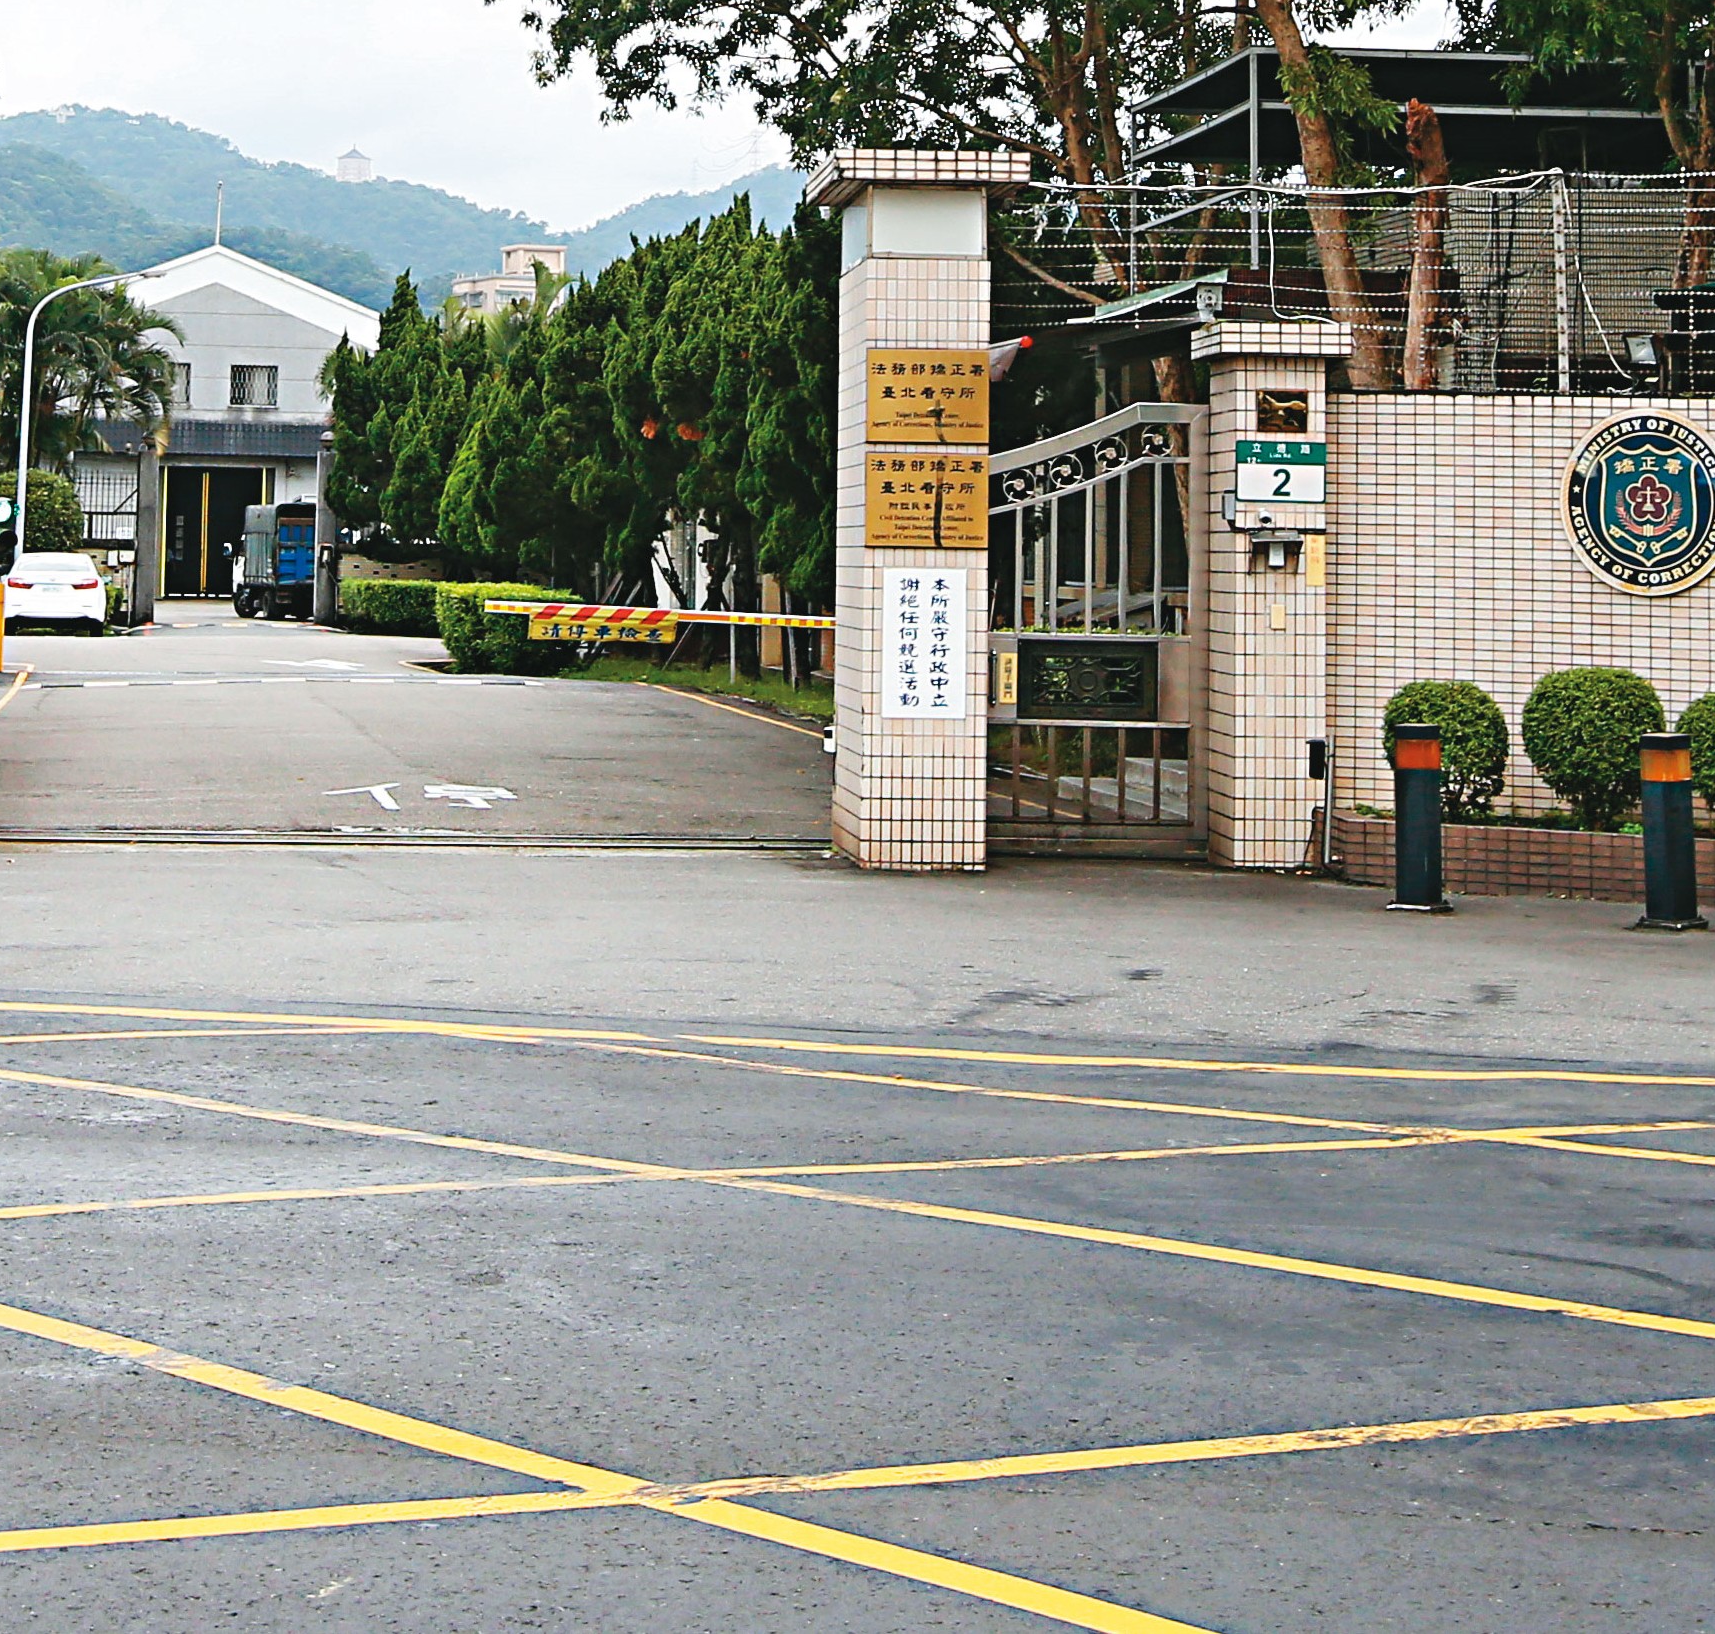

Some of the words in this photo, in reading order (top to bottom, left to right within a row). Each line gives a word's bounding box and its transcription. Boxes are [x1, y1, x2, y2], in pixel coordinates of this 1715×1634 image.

[870, 363, 985, 376] 法務部矯正署
[880, 386, 976, 399] 臺北看守所
[1576, 418, 1642, 475] MINISTRY
[1647, 418, 1668, 431] OF
[870, 459, 985, 473] 法務部矯正署
[1614, 456, 1684, 475] 矯正署
[880, 481, 975, 494] 臺北看守所
[1272, 468, 1292, 497] 2
[888, 502, 966, 511] 附設民事收所
[1571, 505, 1610, 566] AGENCY
[1612, 564, 1634, 580] OF
[541, 623, 664, 642] 請停車檢查
[898, 578, 920, 707] 謝絕任何競選活動
[929, 578, 950, 707] 本所嚴守行政中立
